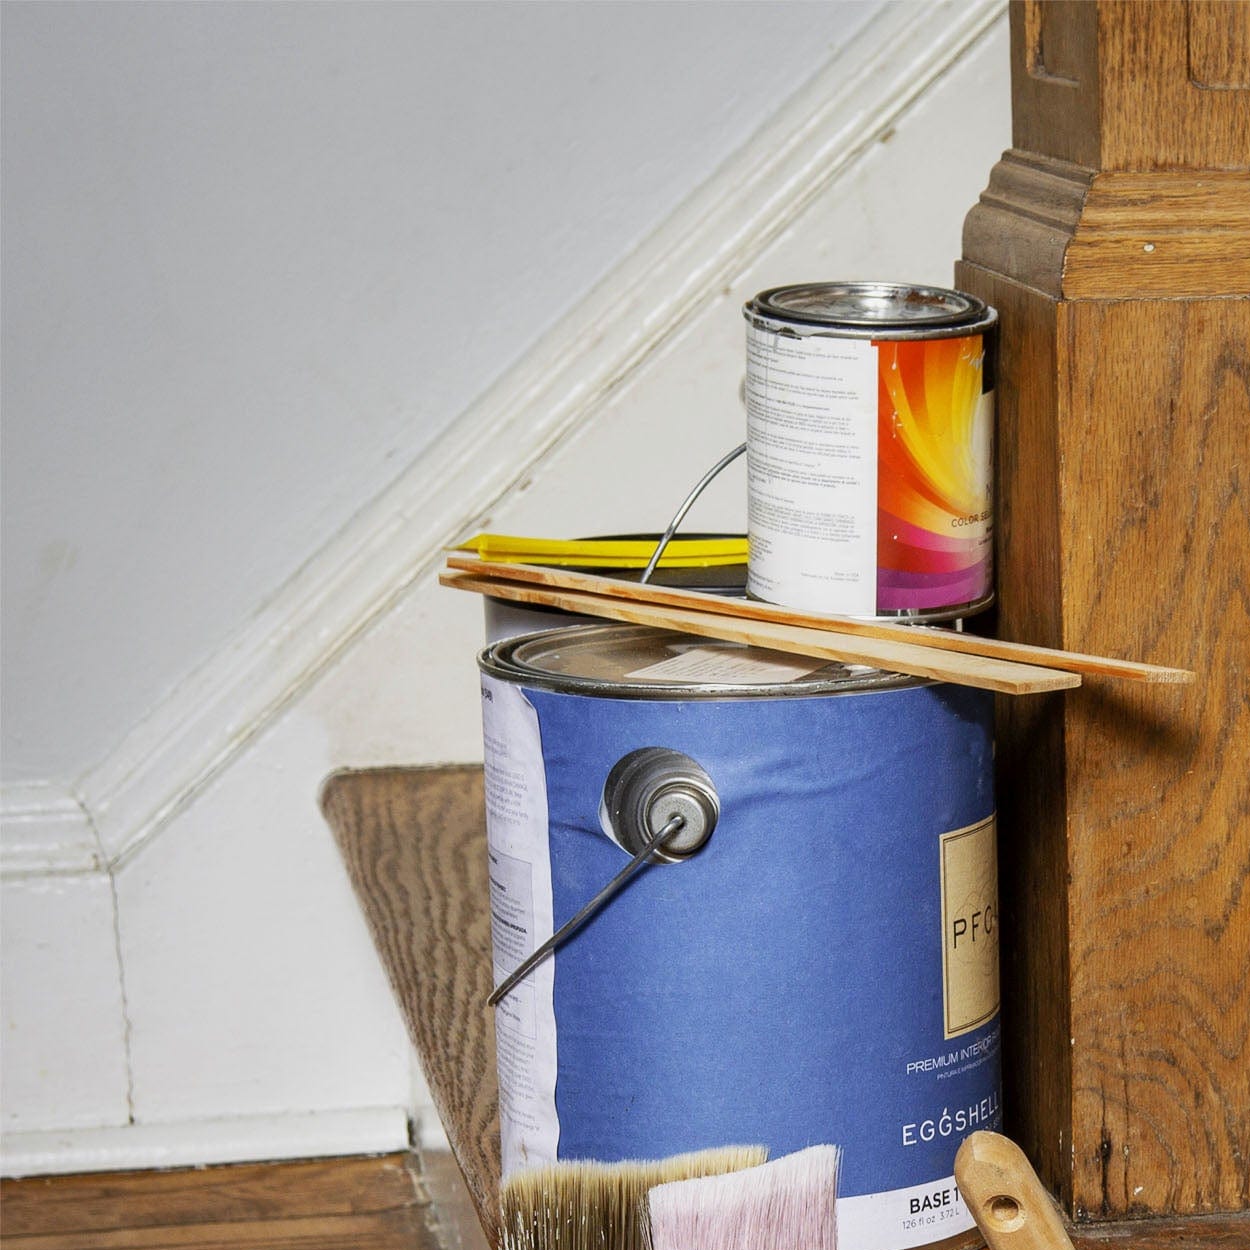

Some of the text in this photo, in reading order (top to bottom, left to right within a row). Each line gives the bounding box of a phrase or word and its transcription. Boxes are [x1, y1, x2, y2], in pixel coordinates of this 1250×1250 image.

[951, 513, 979, 528] COLOR
[906, 1051, 959, 1076] PREMIUM
[909, 1189, 951, 1214] BASE
[902, 1219, 917, 1230] 126
[926, 1215, 936, 1225] oz
